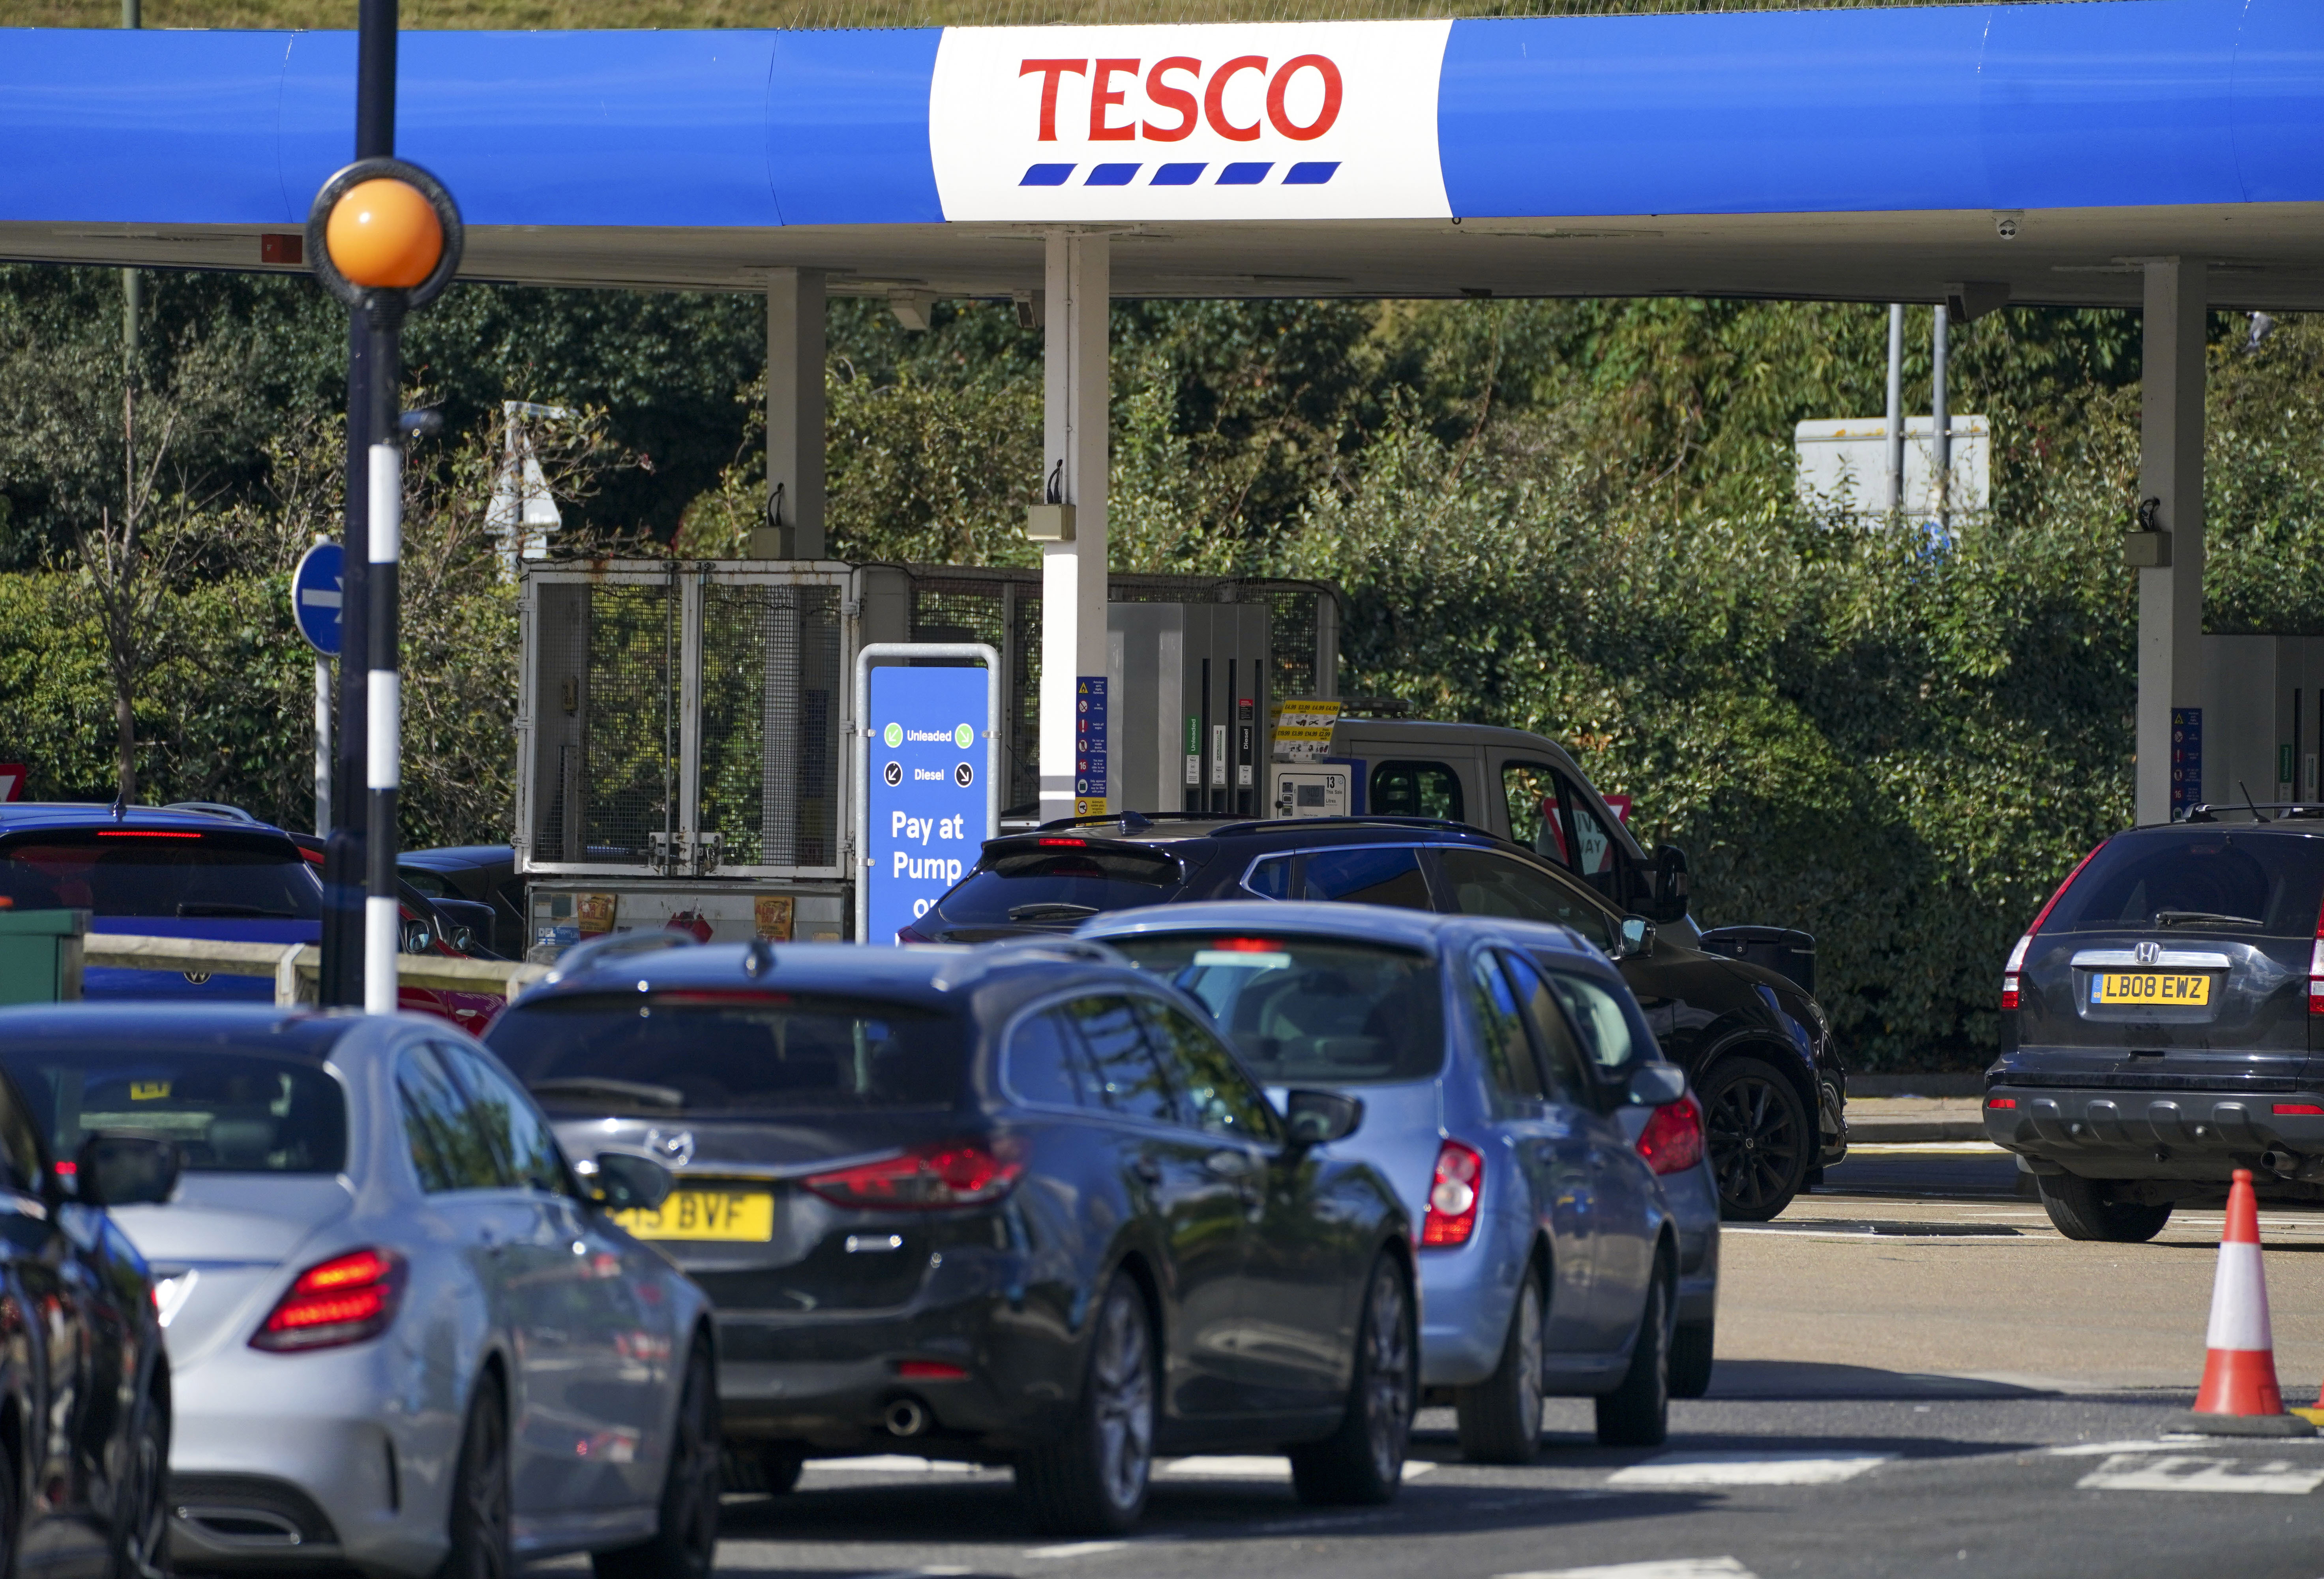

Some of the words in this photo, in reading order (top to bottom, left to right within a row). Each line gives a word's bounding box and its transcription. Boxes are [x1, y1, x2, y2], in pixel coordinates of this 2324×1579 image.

[1018, 54, 1343, 142] TESCO
[907, 729, 952, 742] Unleaded
[915, 768, 944, 781] Diesel
[1326, 776, 1335, 788] 13
[892, 810, 933, 846] Pay
[939, 813, 964, 840] at
[893, 851, 962, 887] Pump
[2106, 976, 2156, 998] LB08
[2162, 977, 2203, 999] EWZ
[679, 1191, 744, 1230] BVF
